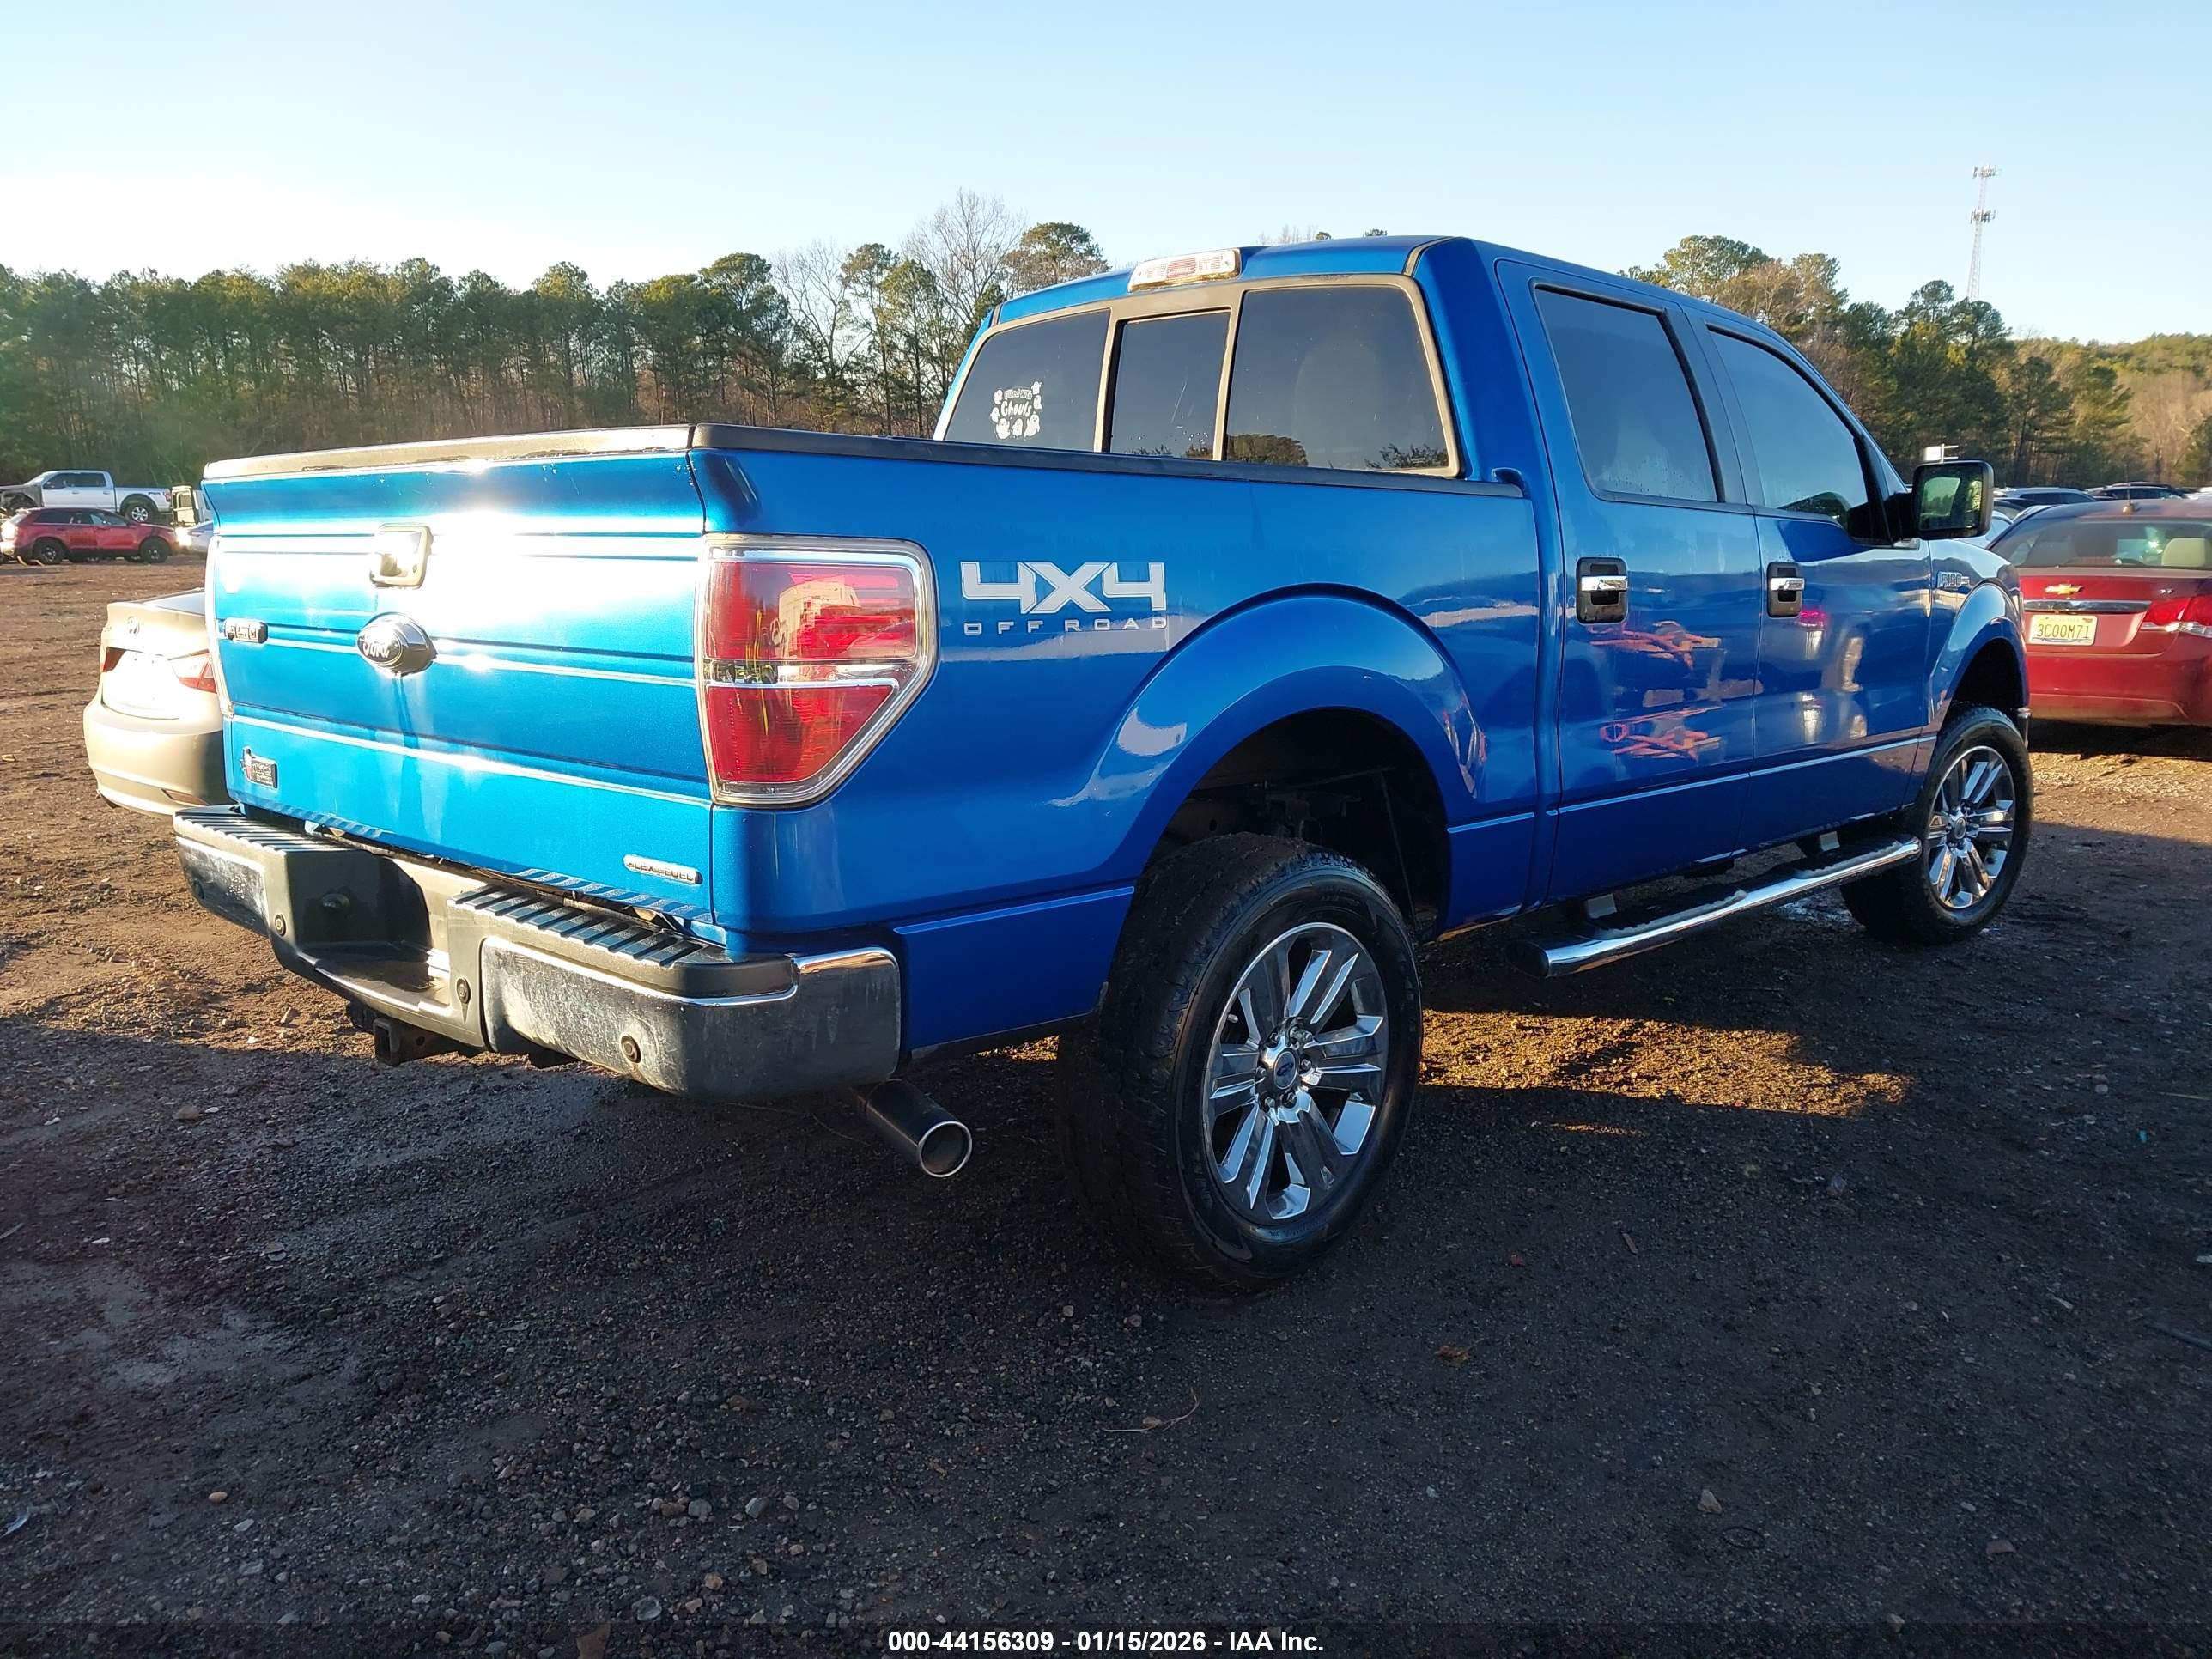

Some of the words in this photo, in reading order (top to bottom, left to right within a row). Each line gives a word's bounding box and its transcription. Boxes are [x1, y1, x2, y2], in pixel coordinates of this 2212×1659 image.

[960, 561, 1167, 614] 4X4
[963, 620, 1043, 635] OFF
[1064, 617, 1168, 633] ROAD
